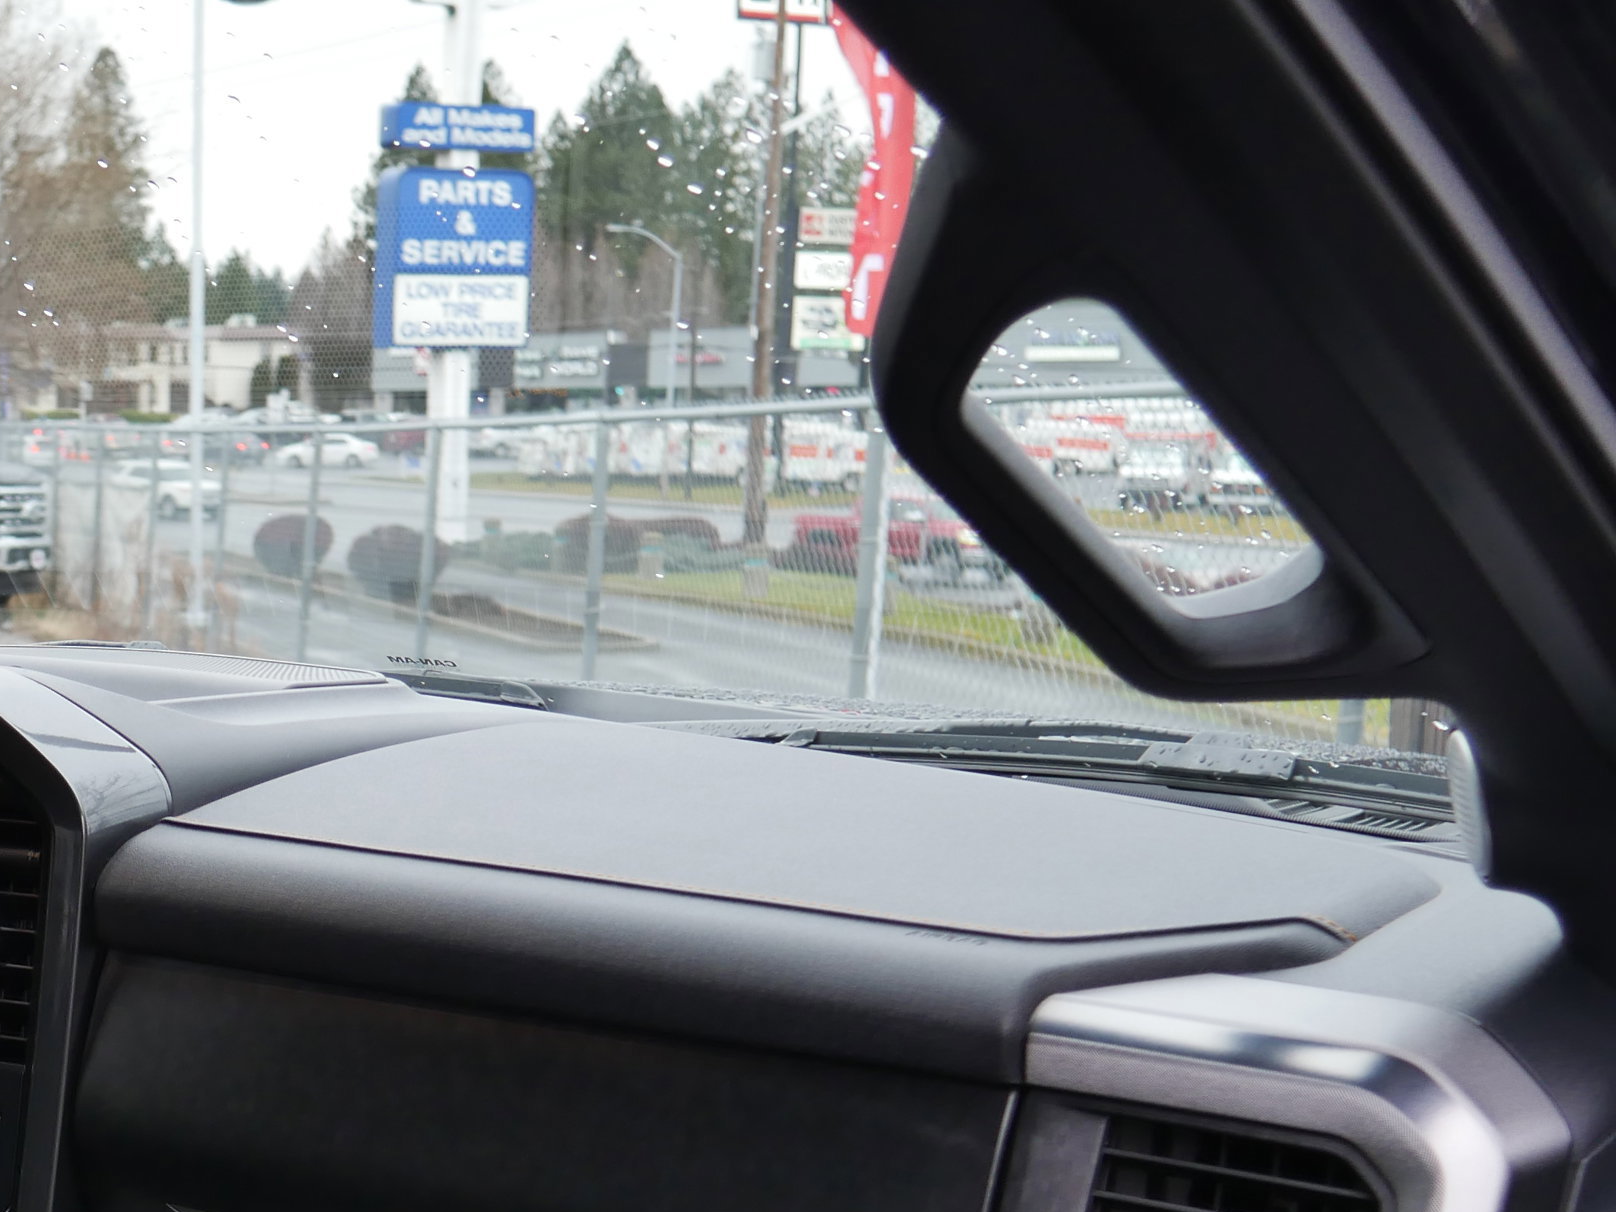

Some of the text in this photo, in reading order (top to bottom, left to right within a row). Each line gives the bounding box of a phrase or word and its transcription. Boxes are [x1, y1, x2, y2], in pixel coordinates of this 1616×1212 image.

[418, 178, 514, 207] PARTS
[454, 210, 476, 236] &
[400, 238, 526, 266] SERVICE
[405, 282, 517, 300] LOW PRICE
[400, 321, 519, 340] GUARANTEE
